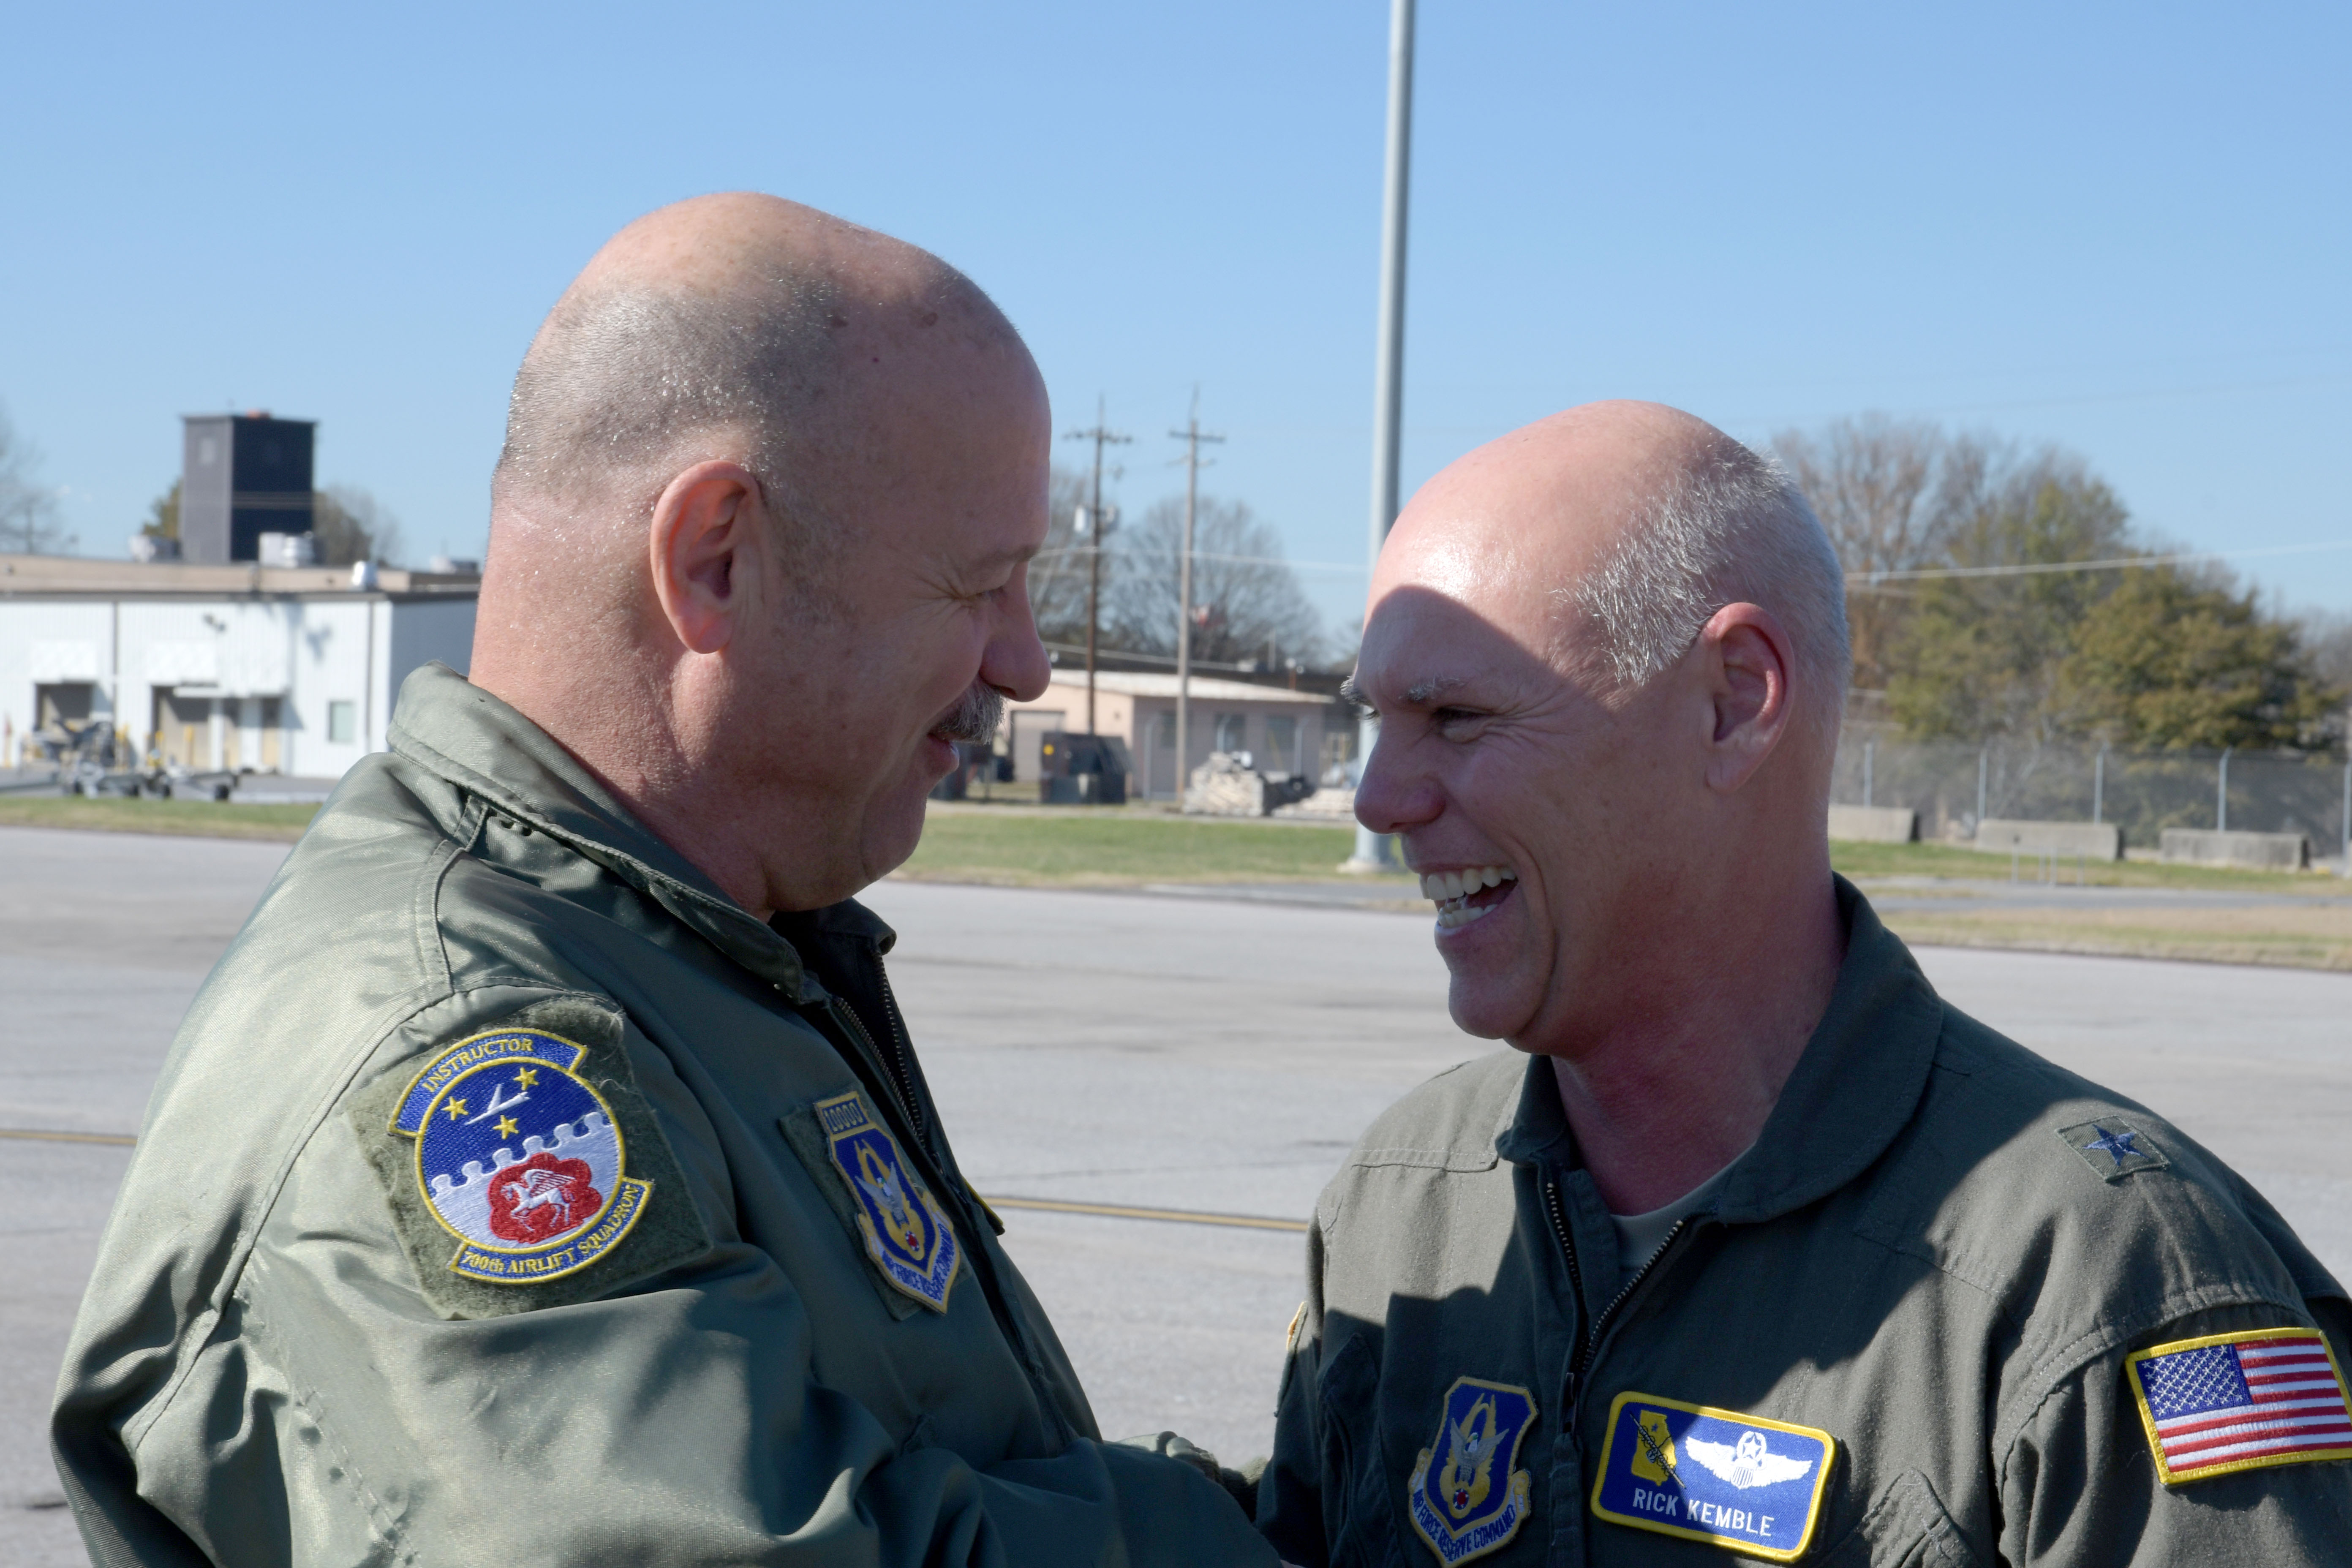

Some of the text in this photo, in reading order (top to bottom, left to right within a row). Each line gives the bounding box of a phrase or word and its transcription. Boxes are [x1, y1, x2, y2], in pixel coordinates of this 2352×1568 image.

[422, 1038, 534, 1092] INSTRUCTOR
[460, 1184, 639, 1274] 700th AIRLIFT SQUADRON
[1633, 1487, 1774, 1537] RICK KEMBLE
